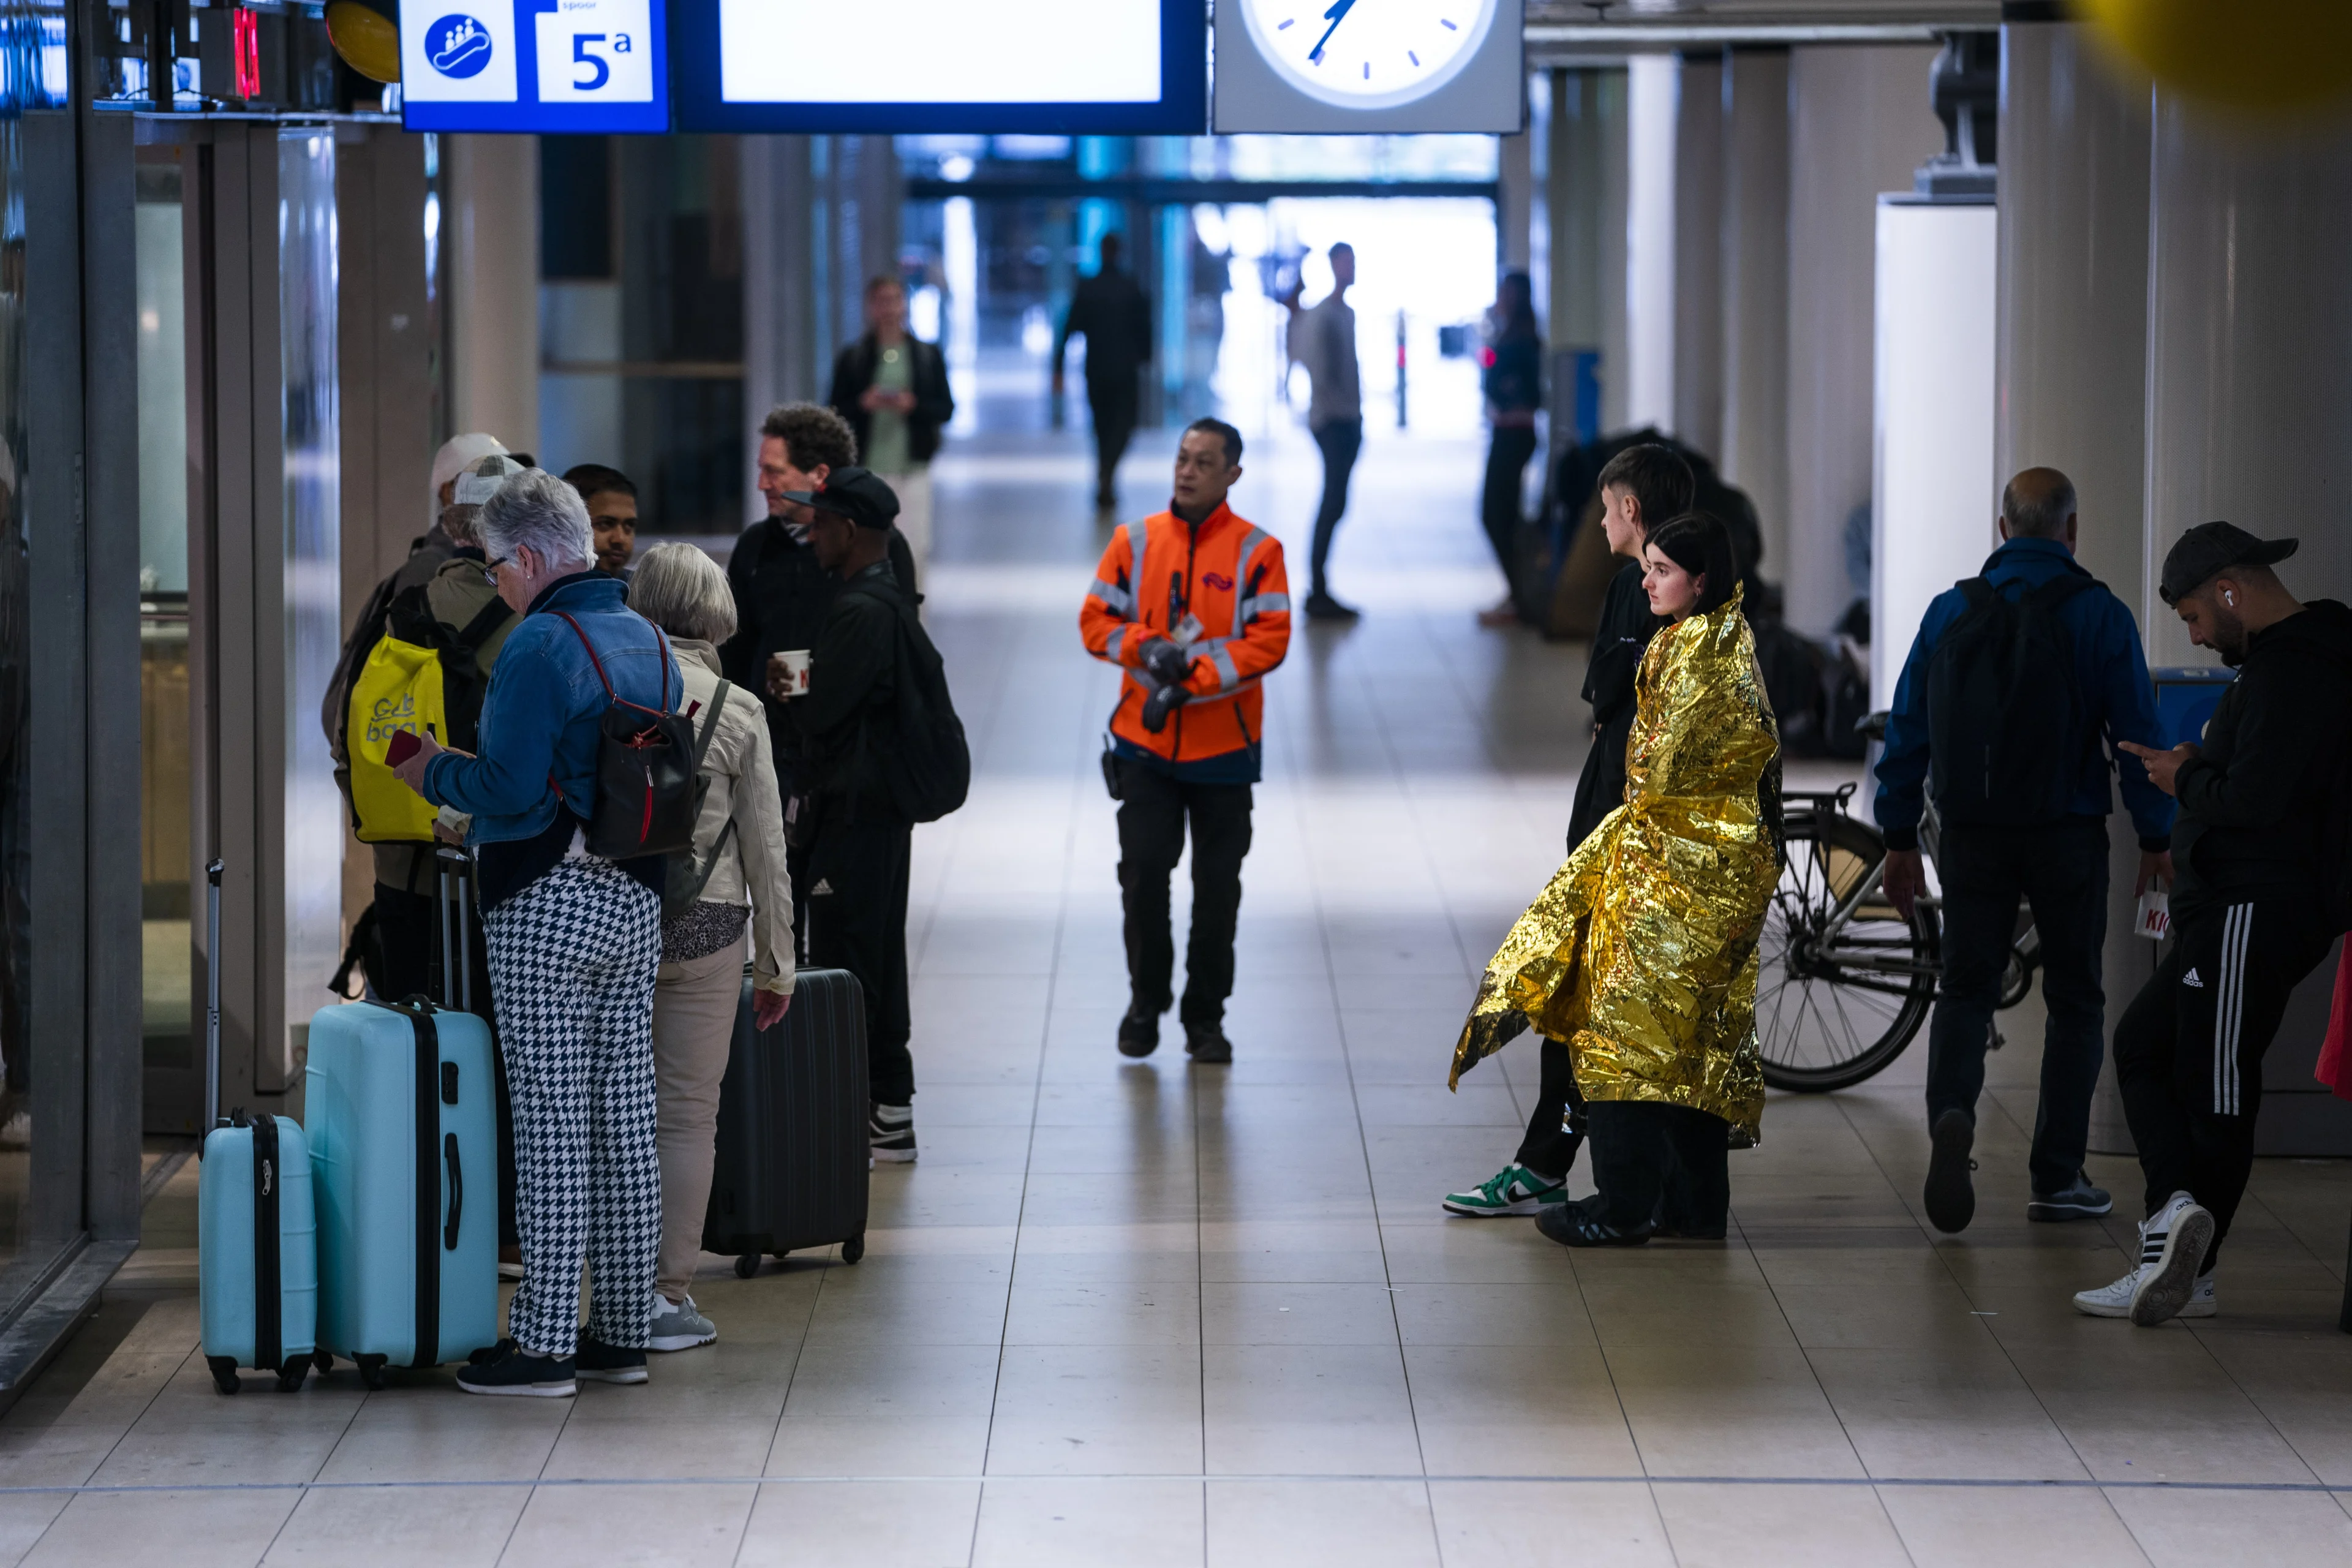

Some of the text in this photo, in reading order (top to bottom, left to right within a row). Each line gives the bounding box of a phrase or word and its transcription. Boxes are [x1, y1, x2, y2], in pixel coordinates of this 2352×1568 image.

[563, 2, 597, 10] spoor
[573, 33, 631, 90] 5a
[371, 693, 415, 720] Gb
[2182, 978, 2204, 987] adidas
